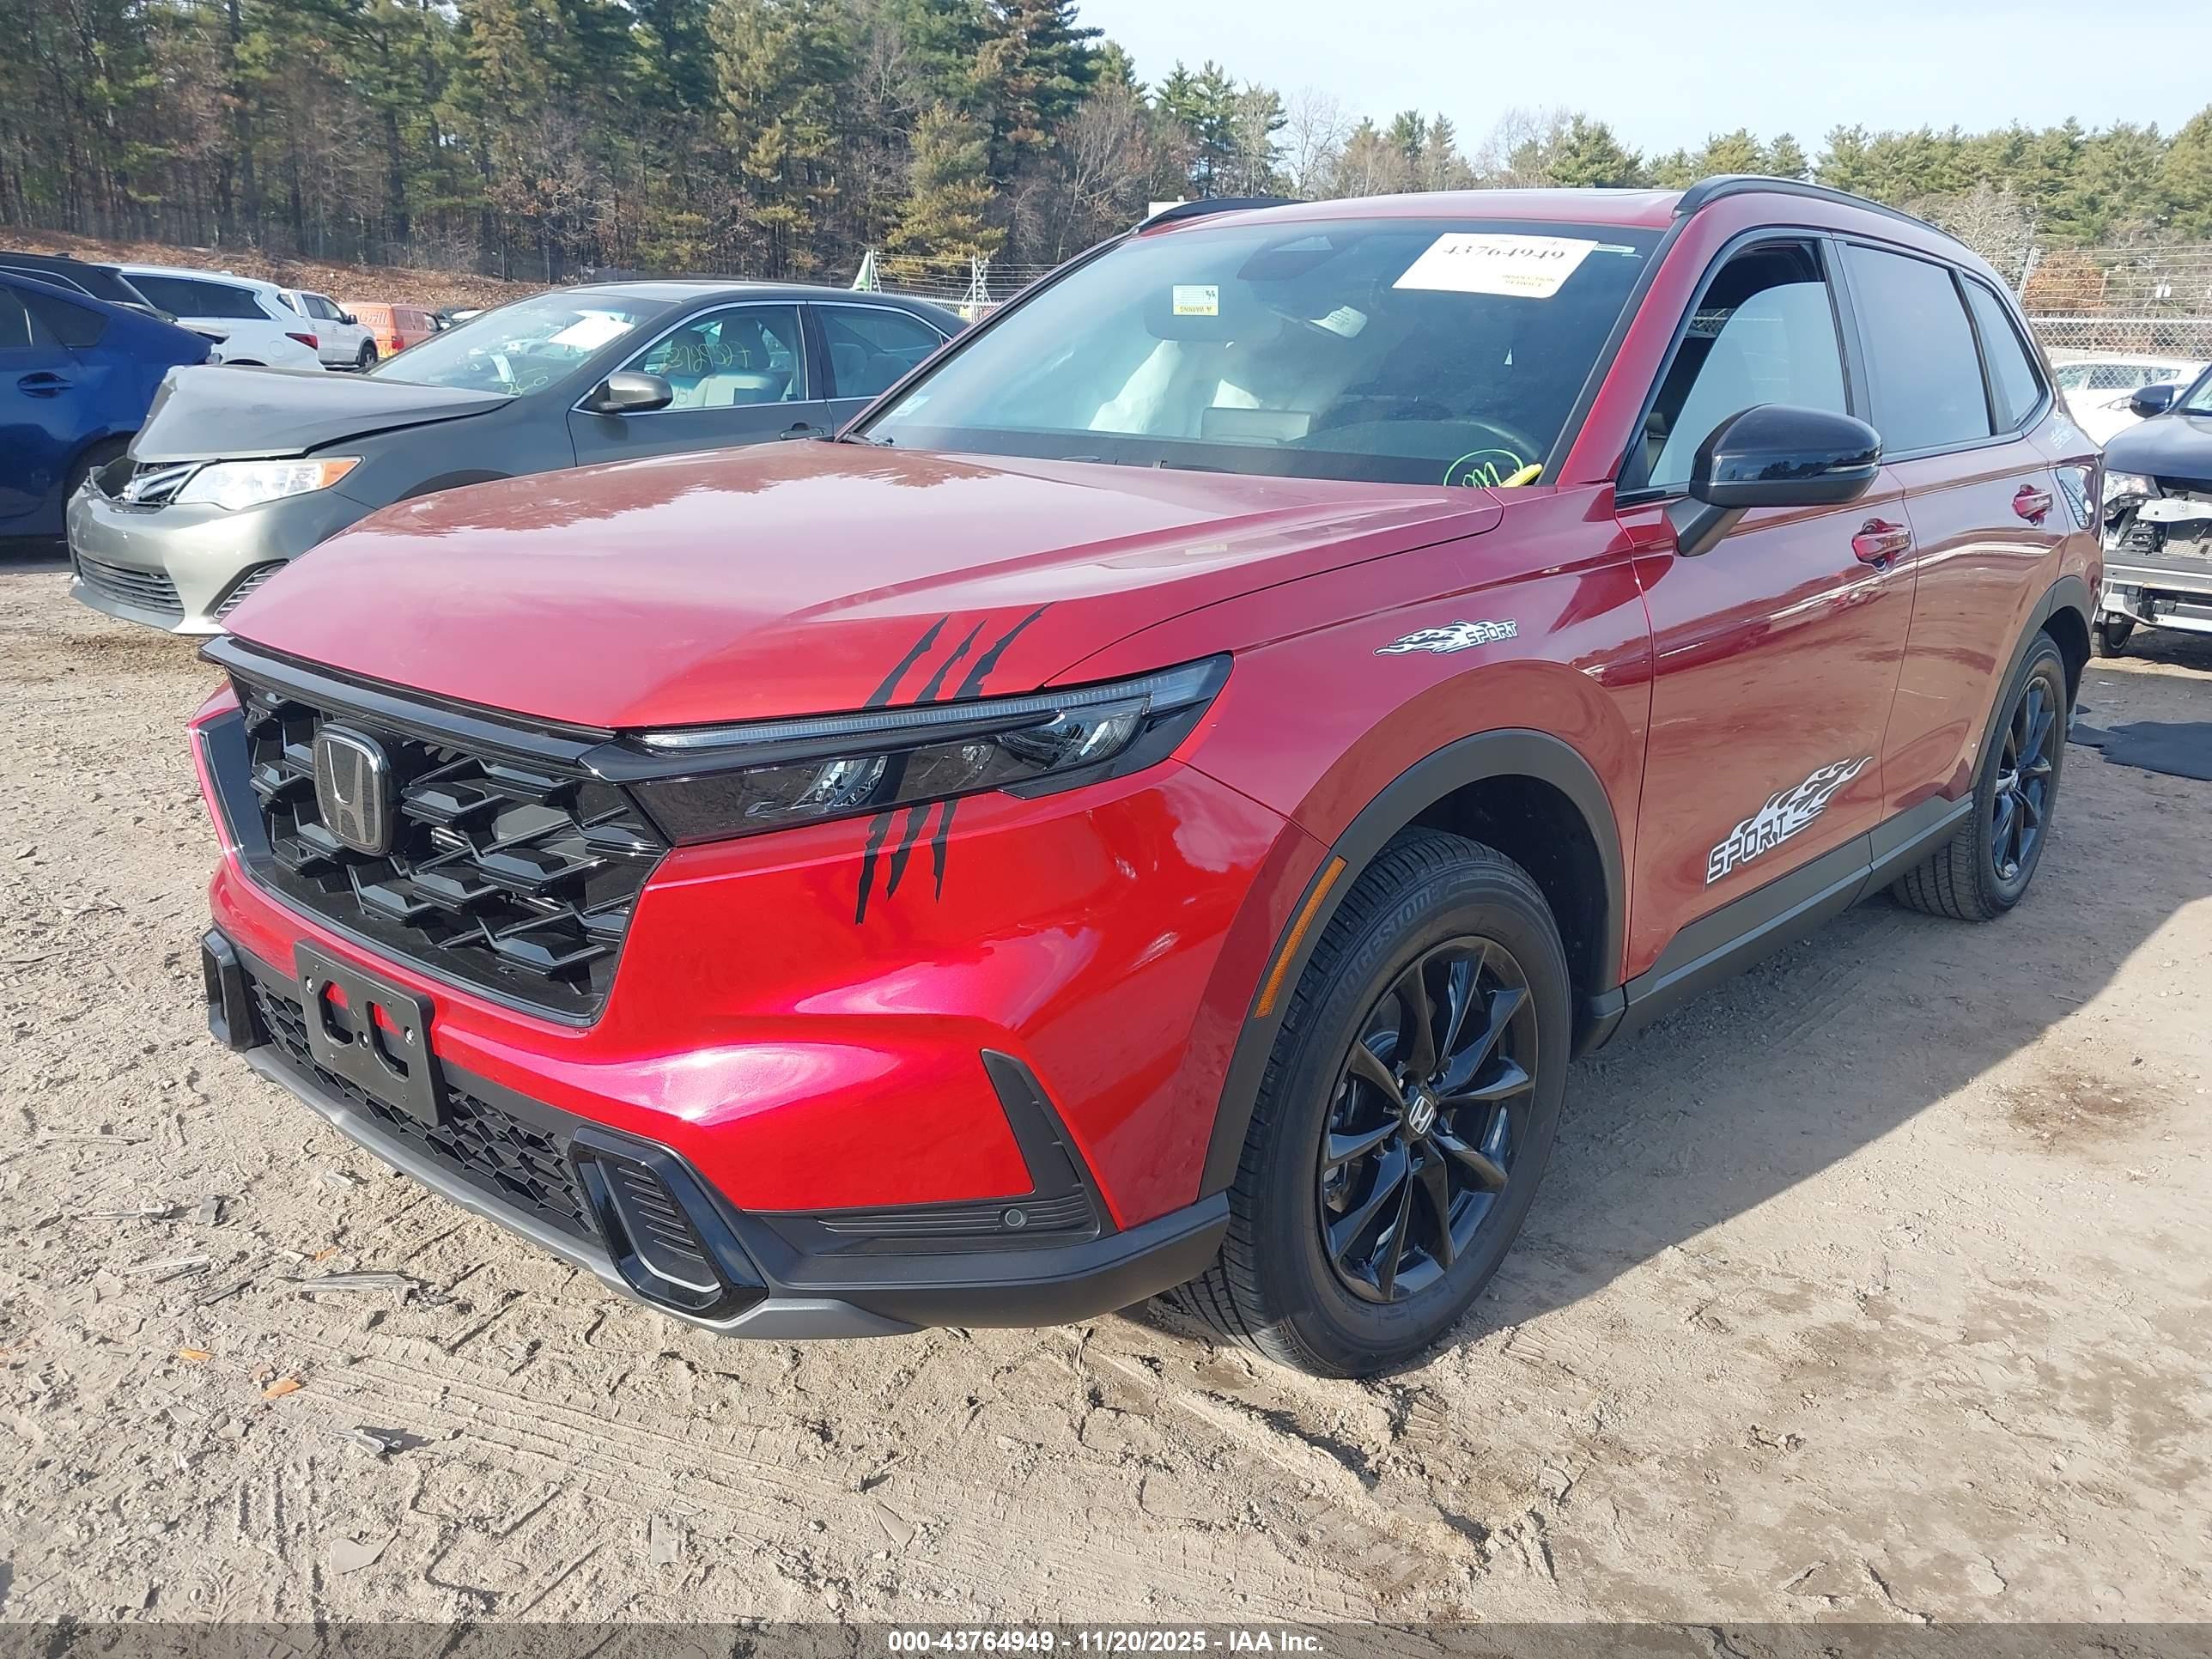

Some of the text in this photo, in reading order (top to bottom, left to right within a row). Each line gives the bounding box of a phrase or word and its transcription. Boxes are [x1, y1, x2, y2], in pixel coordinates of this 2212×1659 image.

[359, 310, 388, 324] Grill
[1465, 622, 1518, 645] SPORT
[1707, 809, 1789, 881] SPORT
